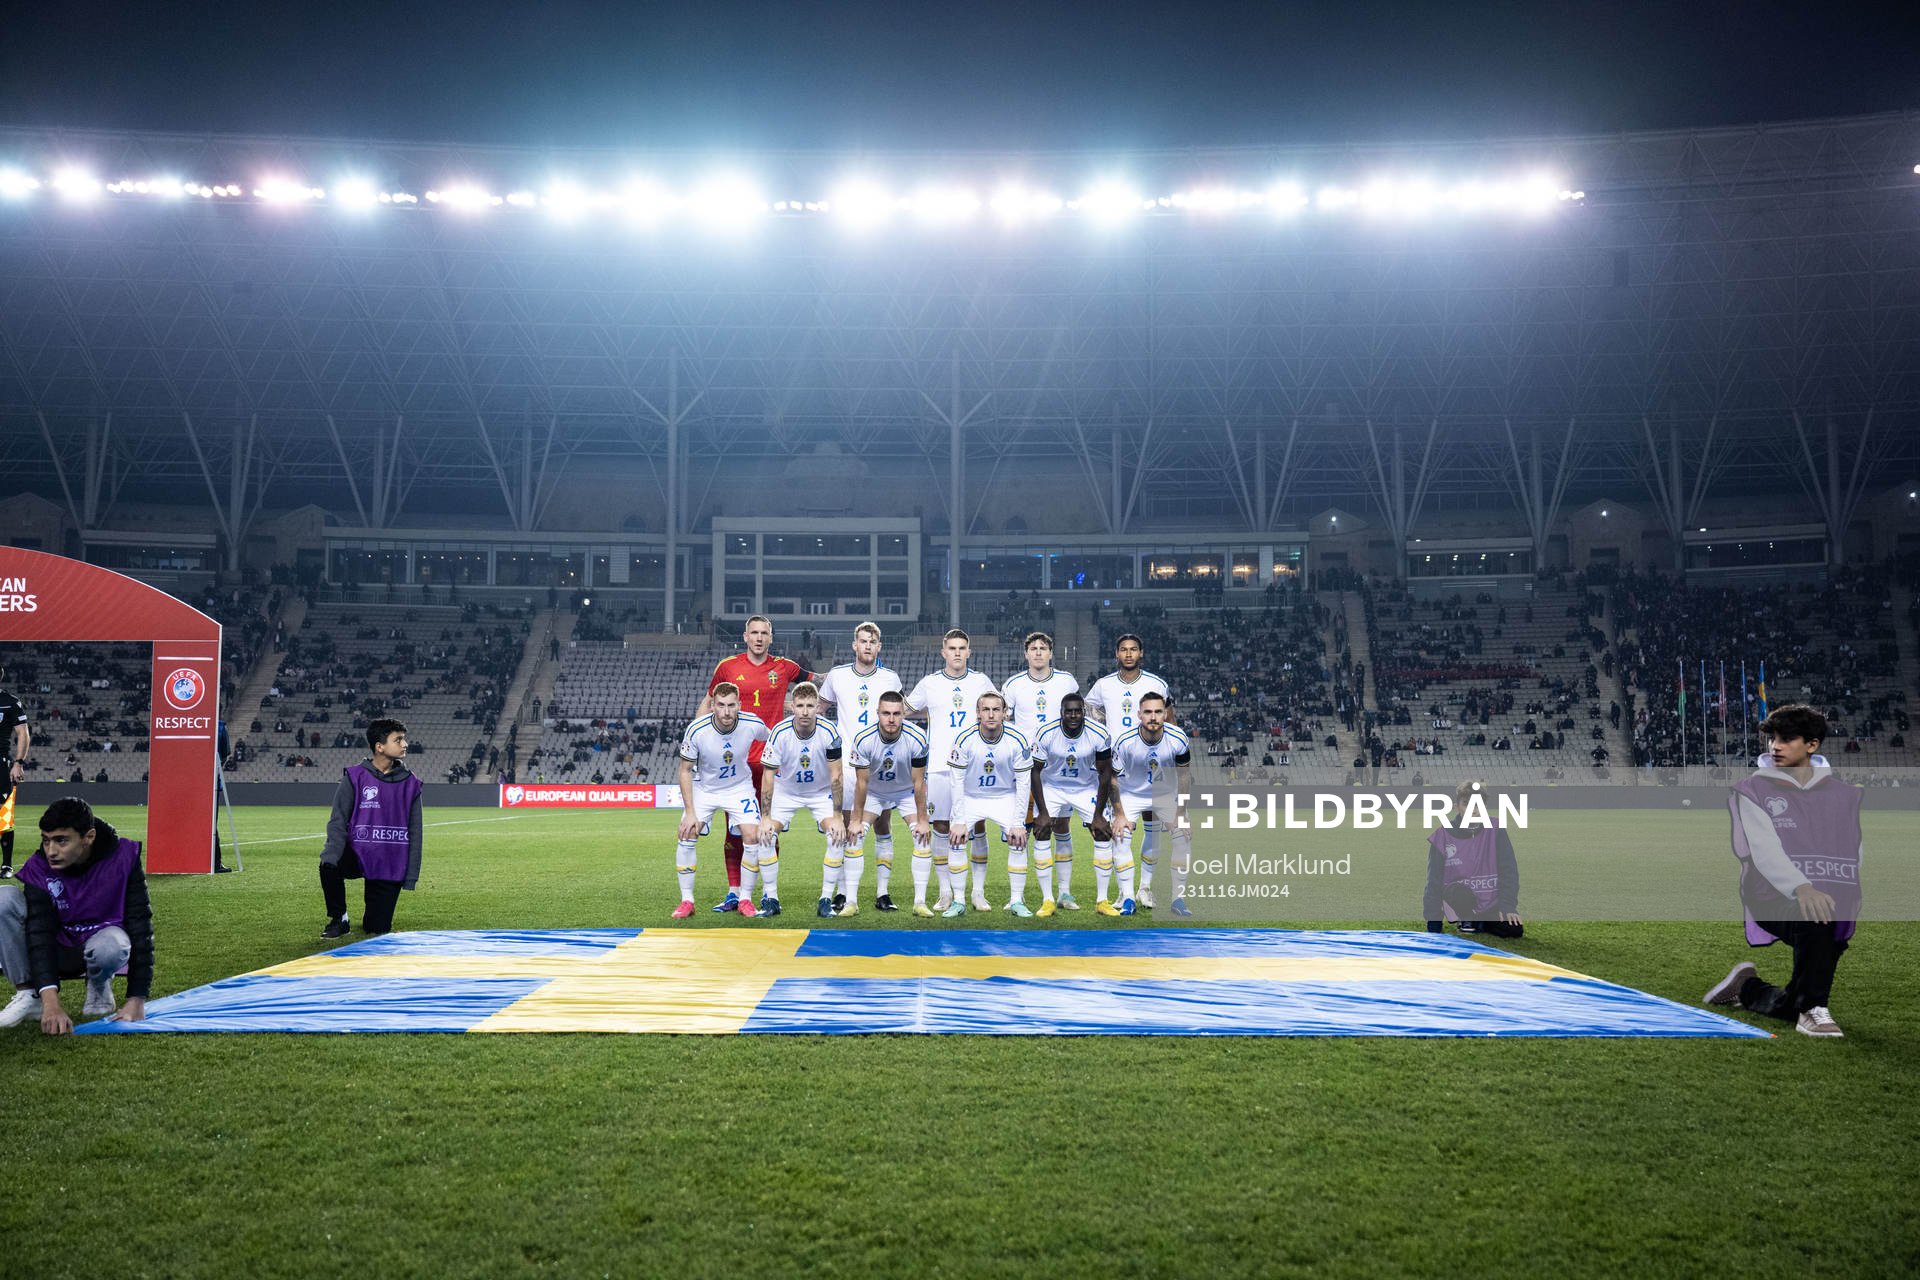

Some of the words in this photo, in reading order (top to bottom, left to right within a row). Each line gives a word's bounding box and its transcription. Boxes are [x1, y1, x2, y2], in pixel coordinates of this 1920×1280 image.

[0, 577, 26, 593] AN
[0, 594, 38, 612] ERS
[172, 671, 196, 681] UEFA
[753, 689, 761, 707] 1
[155, 717, 211, 729] RESPECT
[858, 710, 868, 726] 4
[950, 711, 966, 728] 17
[719, 764, 737, 780] 21
[796, 770, 814, 784] 18
[878, 769, 897, 782] 19
[1061, 768, 1079, 778] 13
[978, 775, 997, 788] 10
[525, 790, 586, 802] EUROPEAN
[589, 790, 653, 802] QUALIFIERS
[740, 798, 760, 814] 21
[1457, 877, 1498, 890] ESPECT
